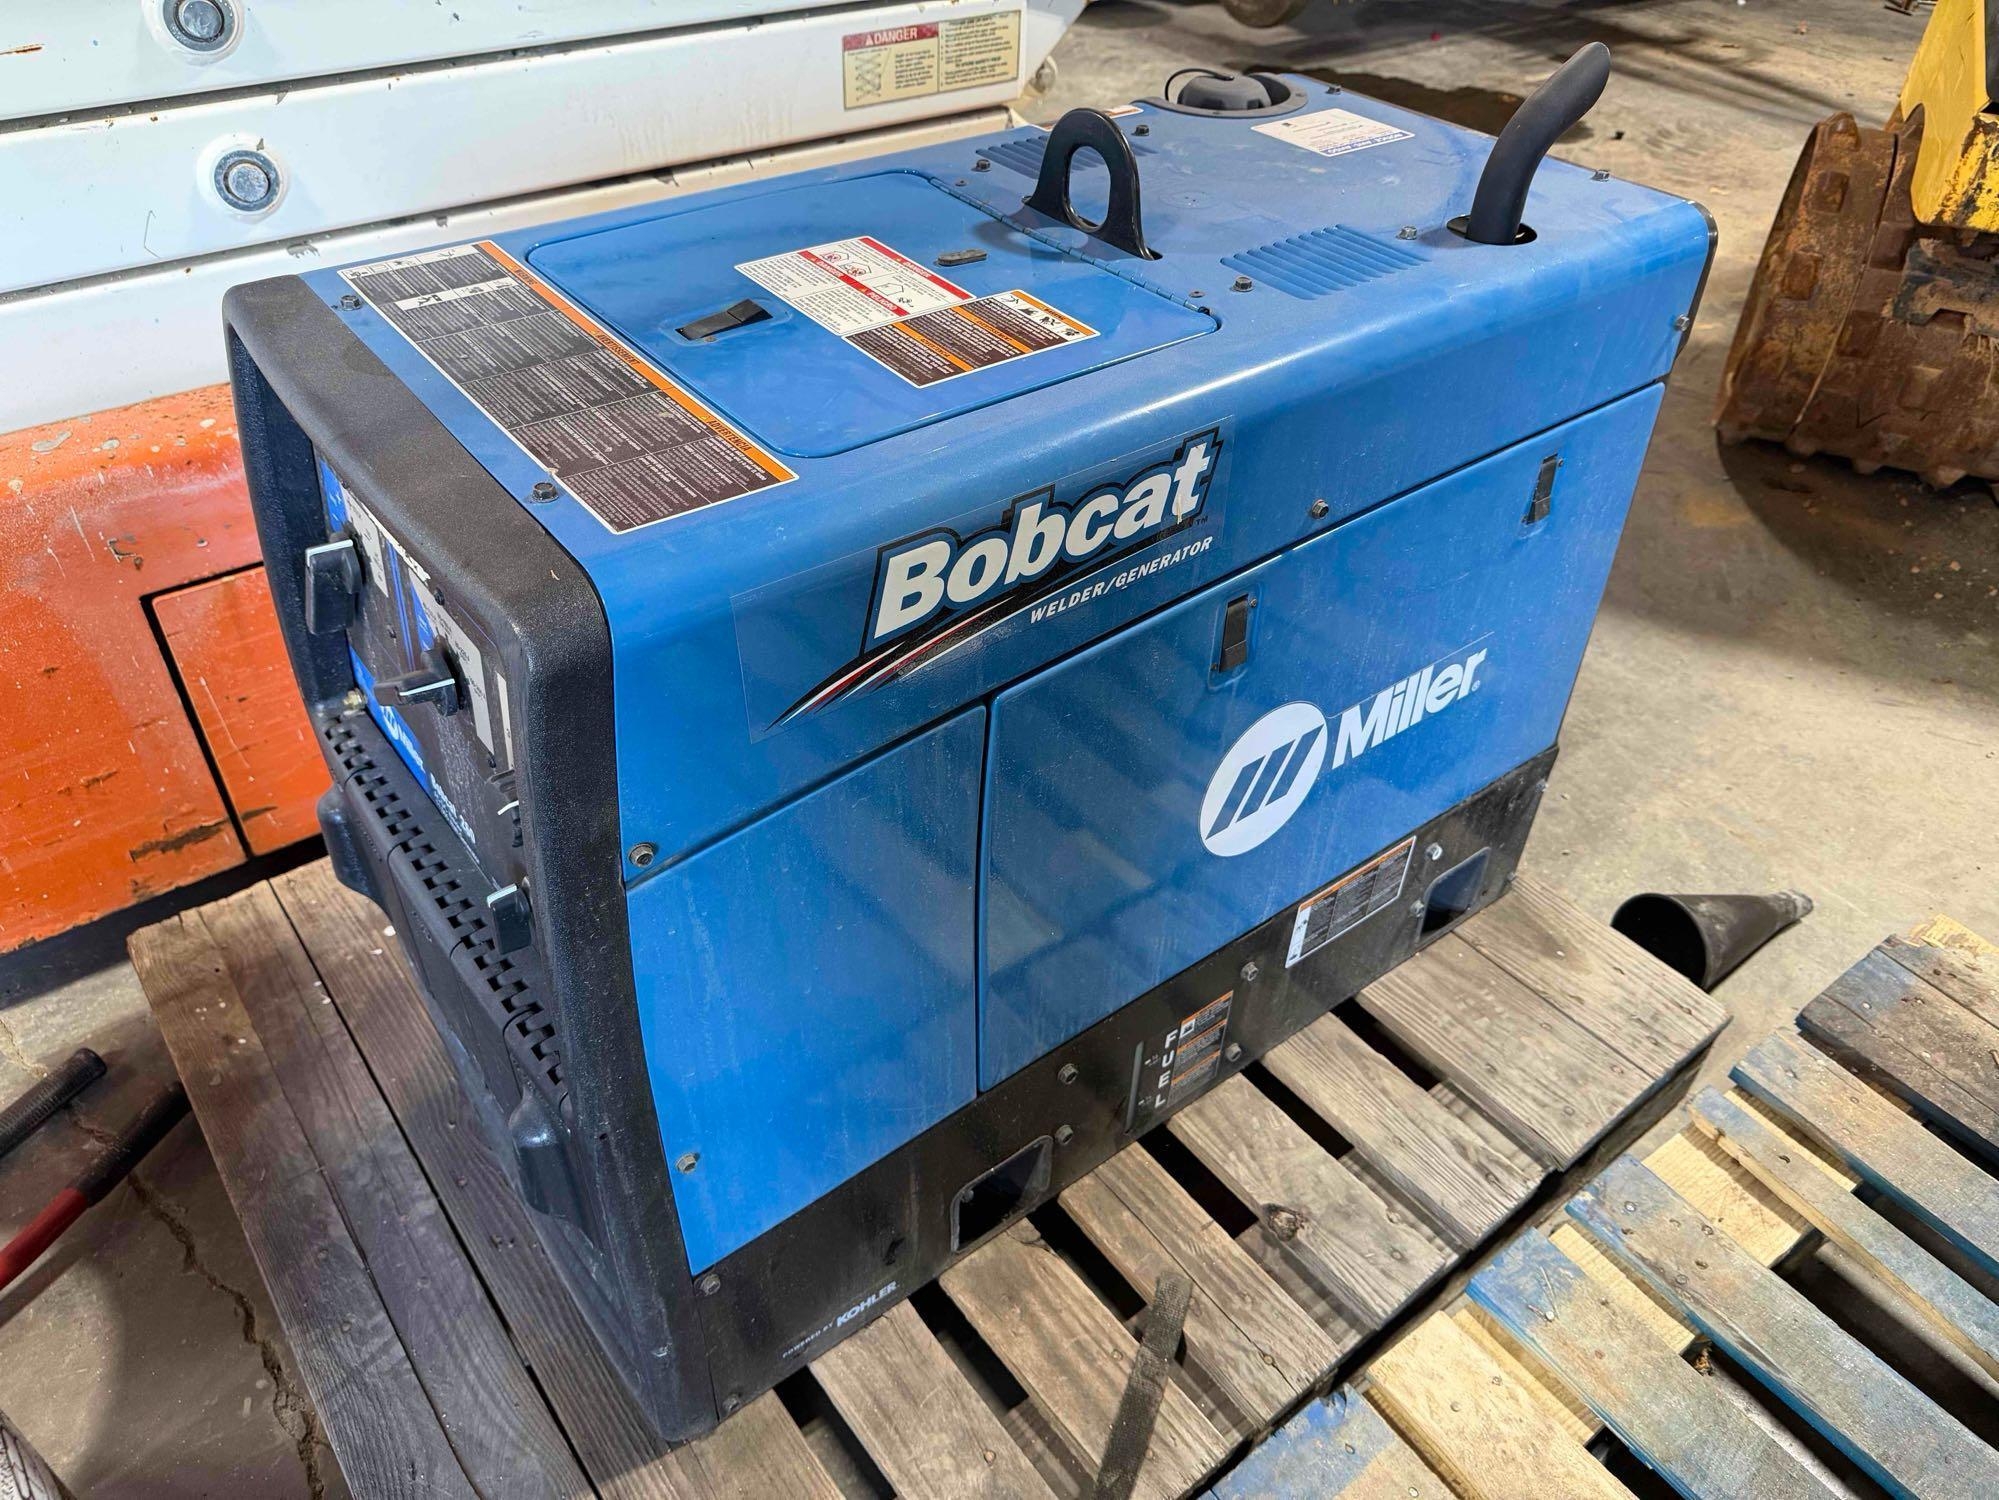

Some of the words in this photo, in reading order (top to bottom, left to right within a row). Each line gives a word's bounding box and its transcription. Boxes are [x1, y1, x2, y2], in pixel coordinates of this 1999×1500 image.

[874, 27, 918, 44] DANGER
[866, 291, 898, 311] PELIGRO
[597, 334, 641, 365] AVERTISSEMENT
[707, 420, 753, 452] ADVERTENCIA
[874, 441, 1210, 639] Bobcat
[1029, 535, 1214, 625] WELDER/GENERATOR
[1332, 647, 1488, 770] Miller
[1154, 1028, 1179, 1109] FUEL
[836, 1280, 898, 1328] KOHLER
